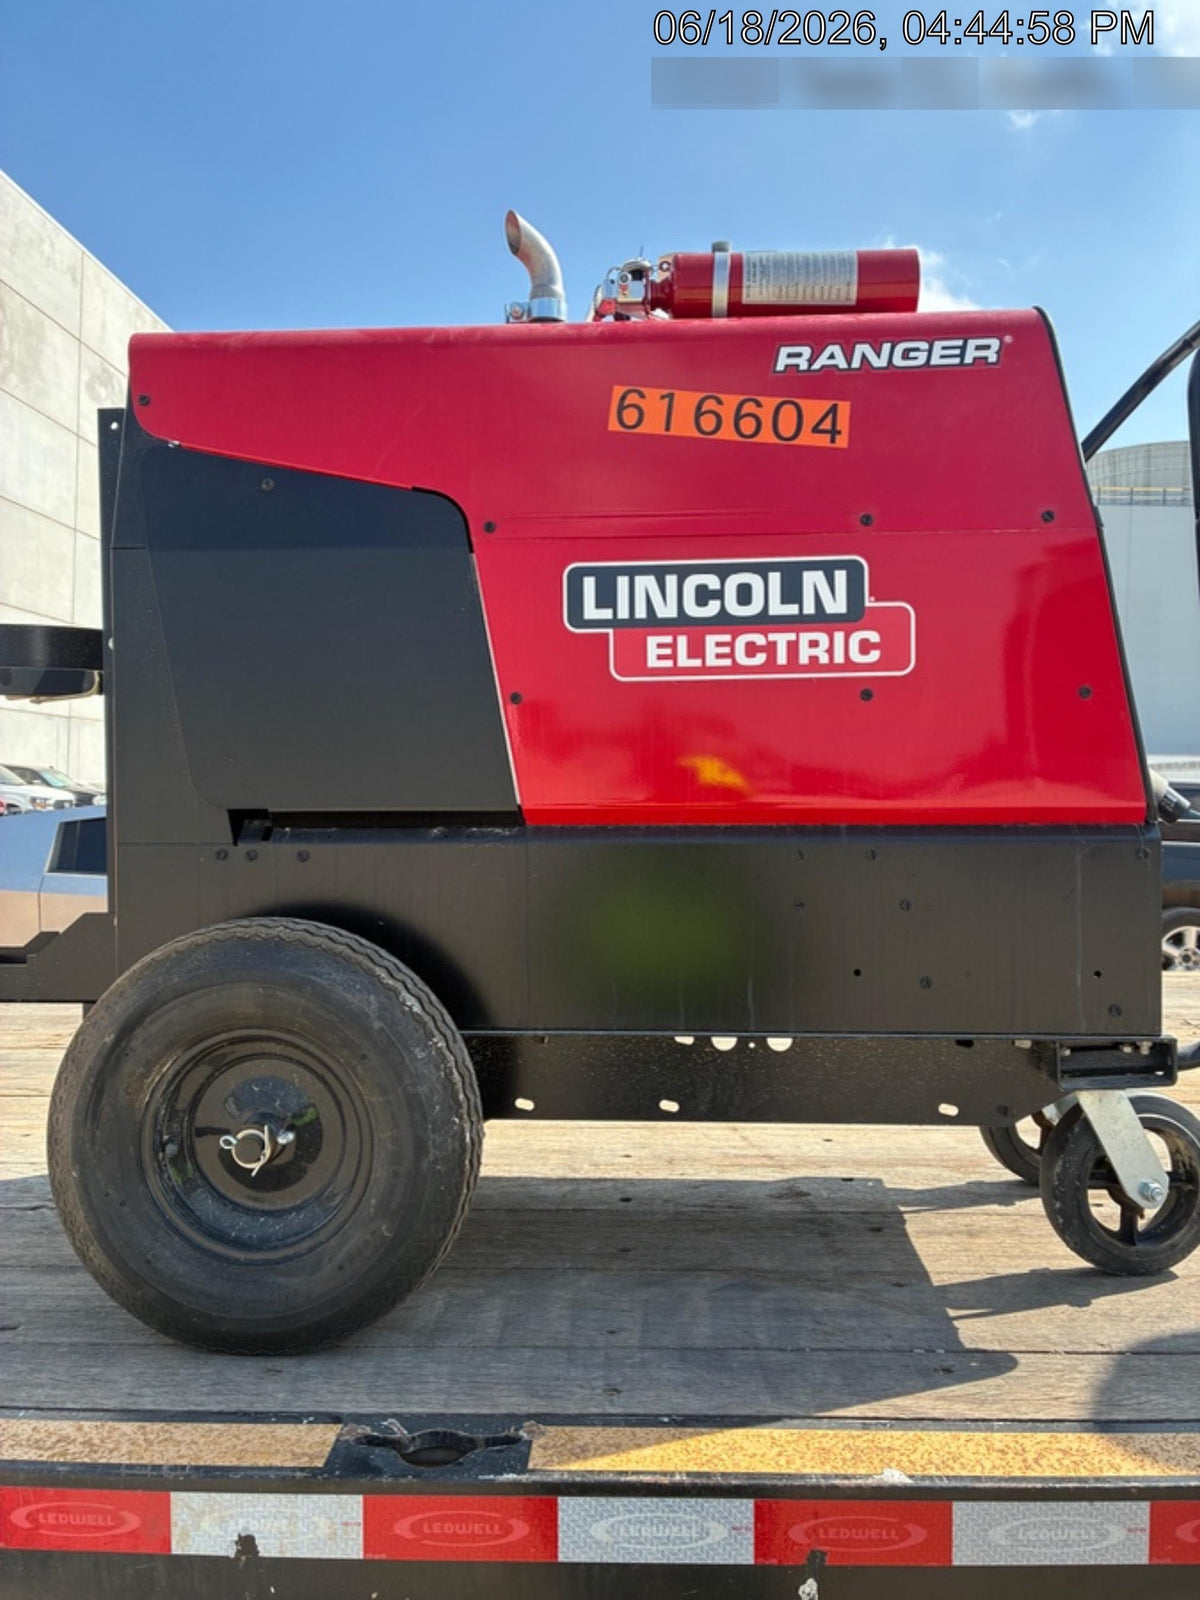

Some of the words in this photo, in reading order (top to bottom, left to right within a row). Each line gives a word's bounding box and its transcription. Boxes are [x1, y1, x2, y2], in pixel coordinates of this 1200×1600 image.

[774, 337, 1001, 373] RANGER
[614, 386, 843, 445] 616604
[582, 569, 848, 620] LINCOLN
[646, 630, 881, 668] ELECTRIC
[37, 1512, 116, 1527] LEDWELL
[422, 1521, 503, 1536] LEDWELL
[817, 1527, 900, 1541] LEDWELL
